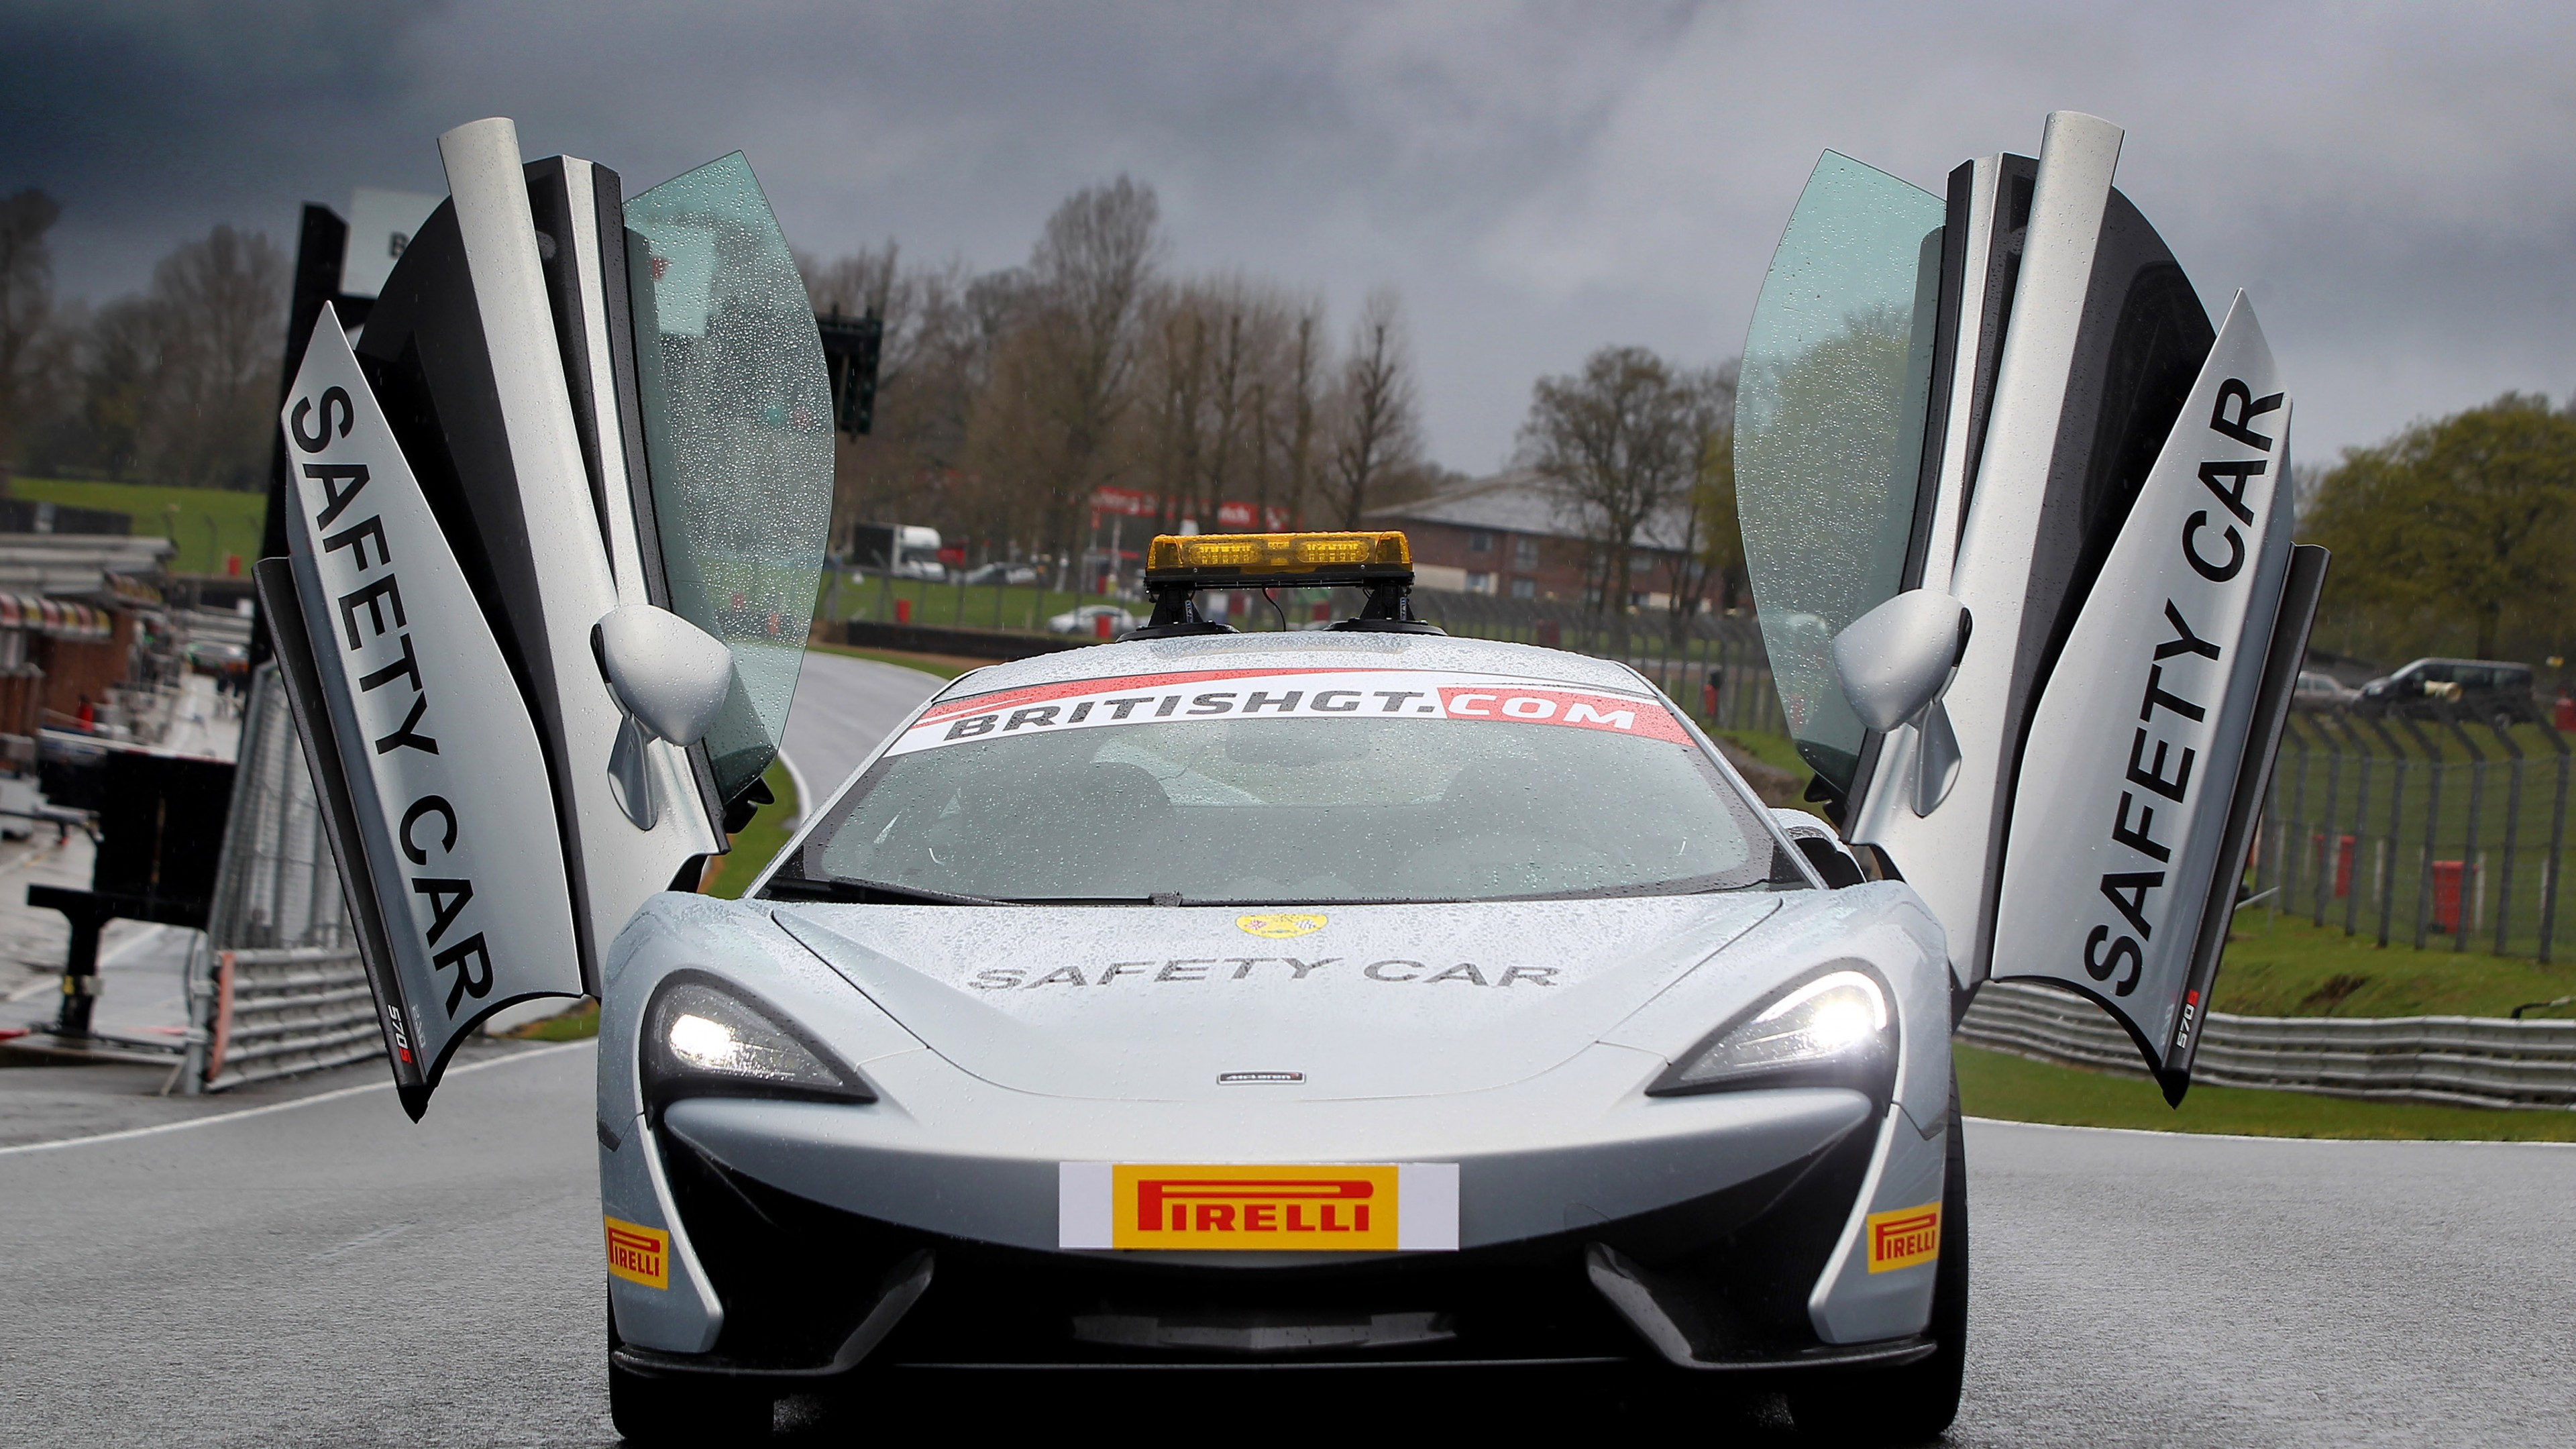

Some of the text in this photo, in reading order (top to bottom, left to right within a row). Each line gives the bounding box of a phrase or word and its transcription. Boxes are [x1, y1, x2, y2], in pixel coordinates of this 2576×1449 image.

[290, 385, 494, 1020] SAFETY CAR
[2083, 377, 2284, 997] SAFETY CAR
[943, 690, 1637, 741] BRITISHGT.COM
[967, 957, 1560, 989] SAFETY CAR
[388, 1004, 413, 1064] 570S
[1138, 1179, 1374, 1231] PIRELLI
[608, 1226, 661, 1277] PIRELLI
[1876, 1212, 1937, 1261] PIRELLI
